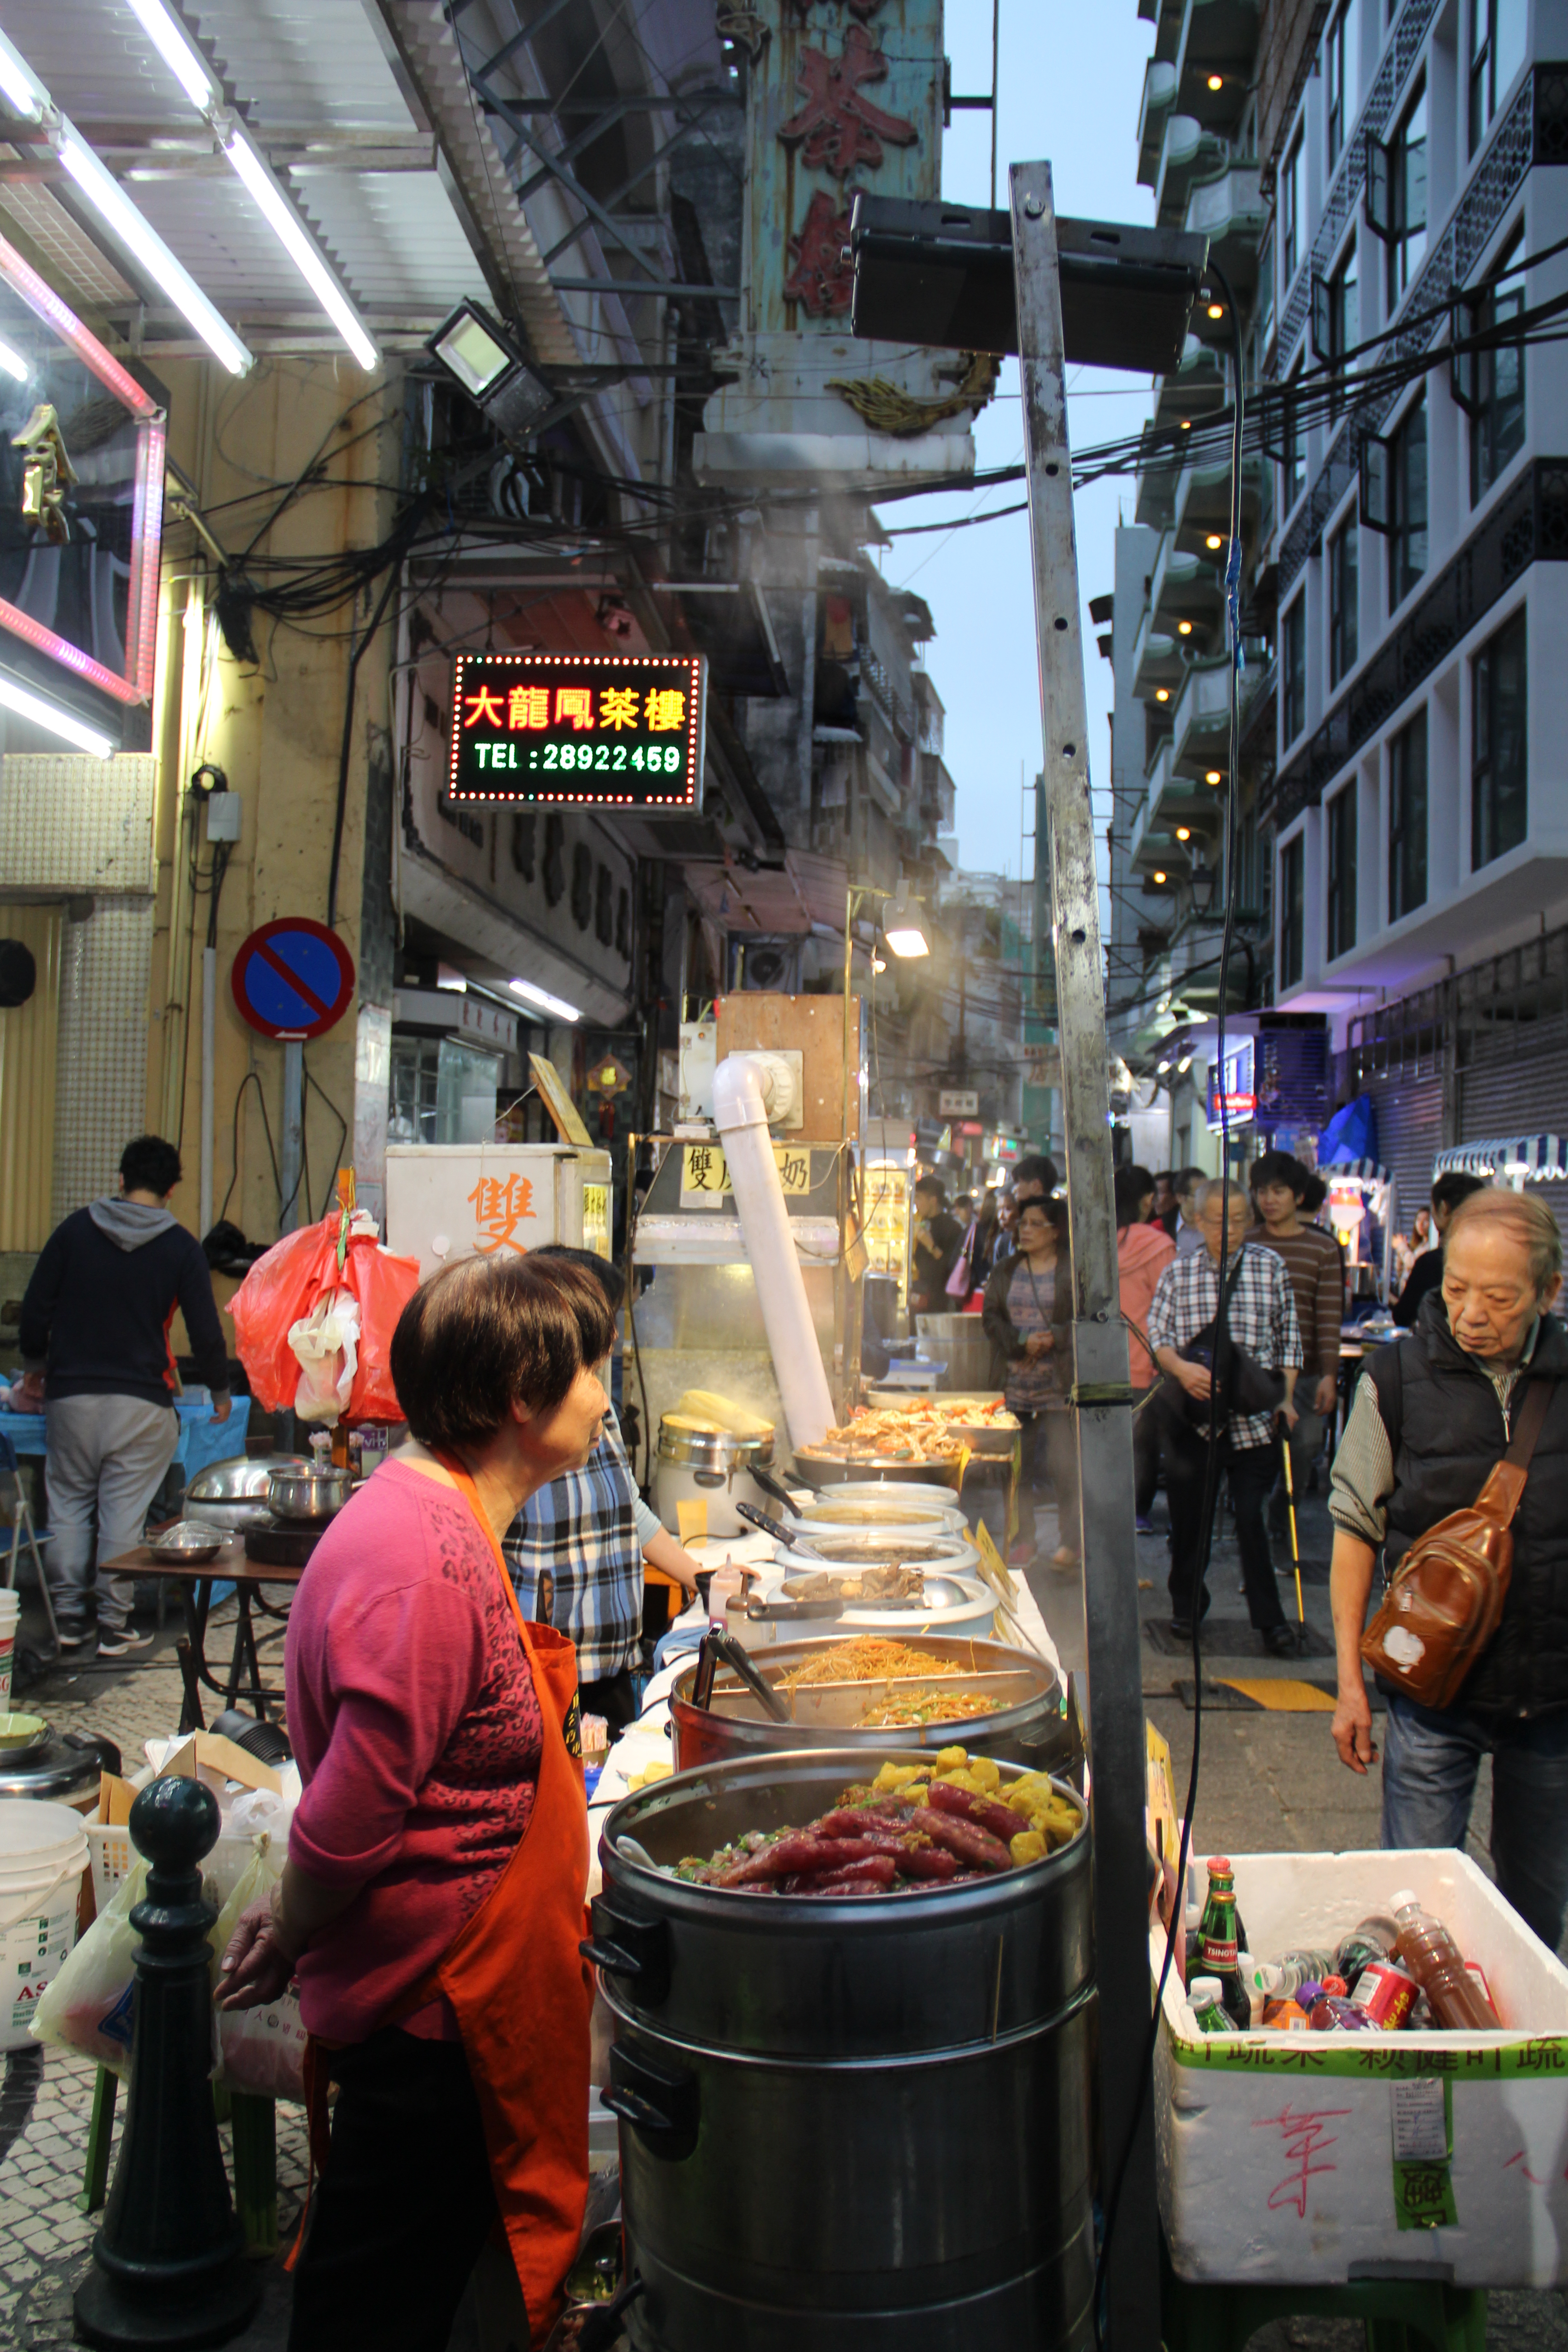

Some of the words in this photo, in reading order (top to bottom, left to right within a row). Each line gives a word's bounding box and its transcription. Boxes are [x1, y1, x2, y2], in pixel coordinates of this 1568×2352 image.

[465, 684, 686, 731] 大龍鳳茶樓
[467, 1172, 537, 1255] 雙
